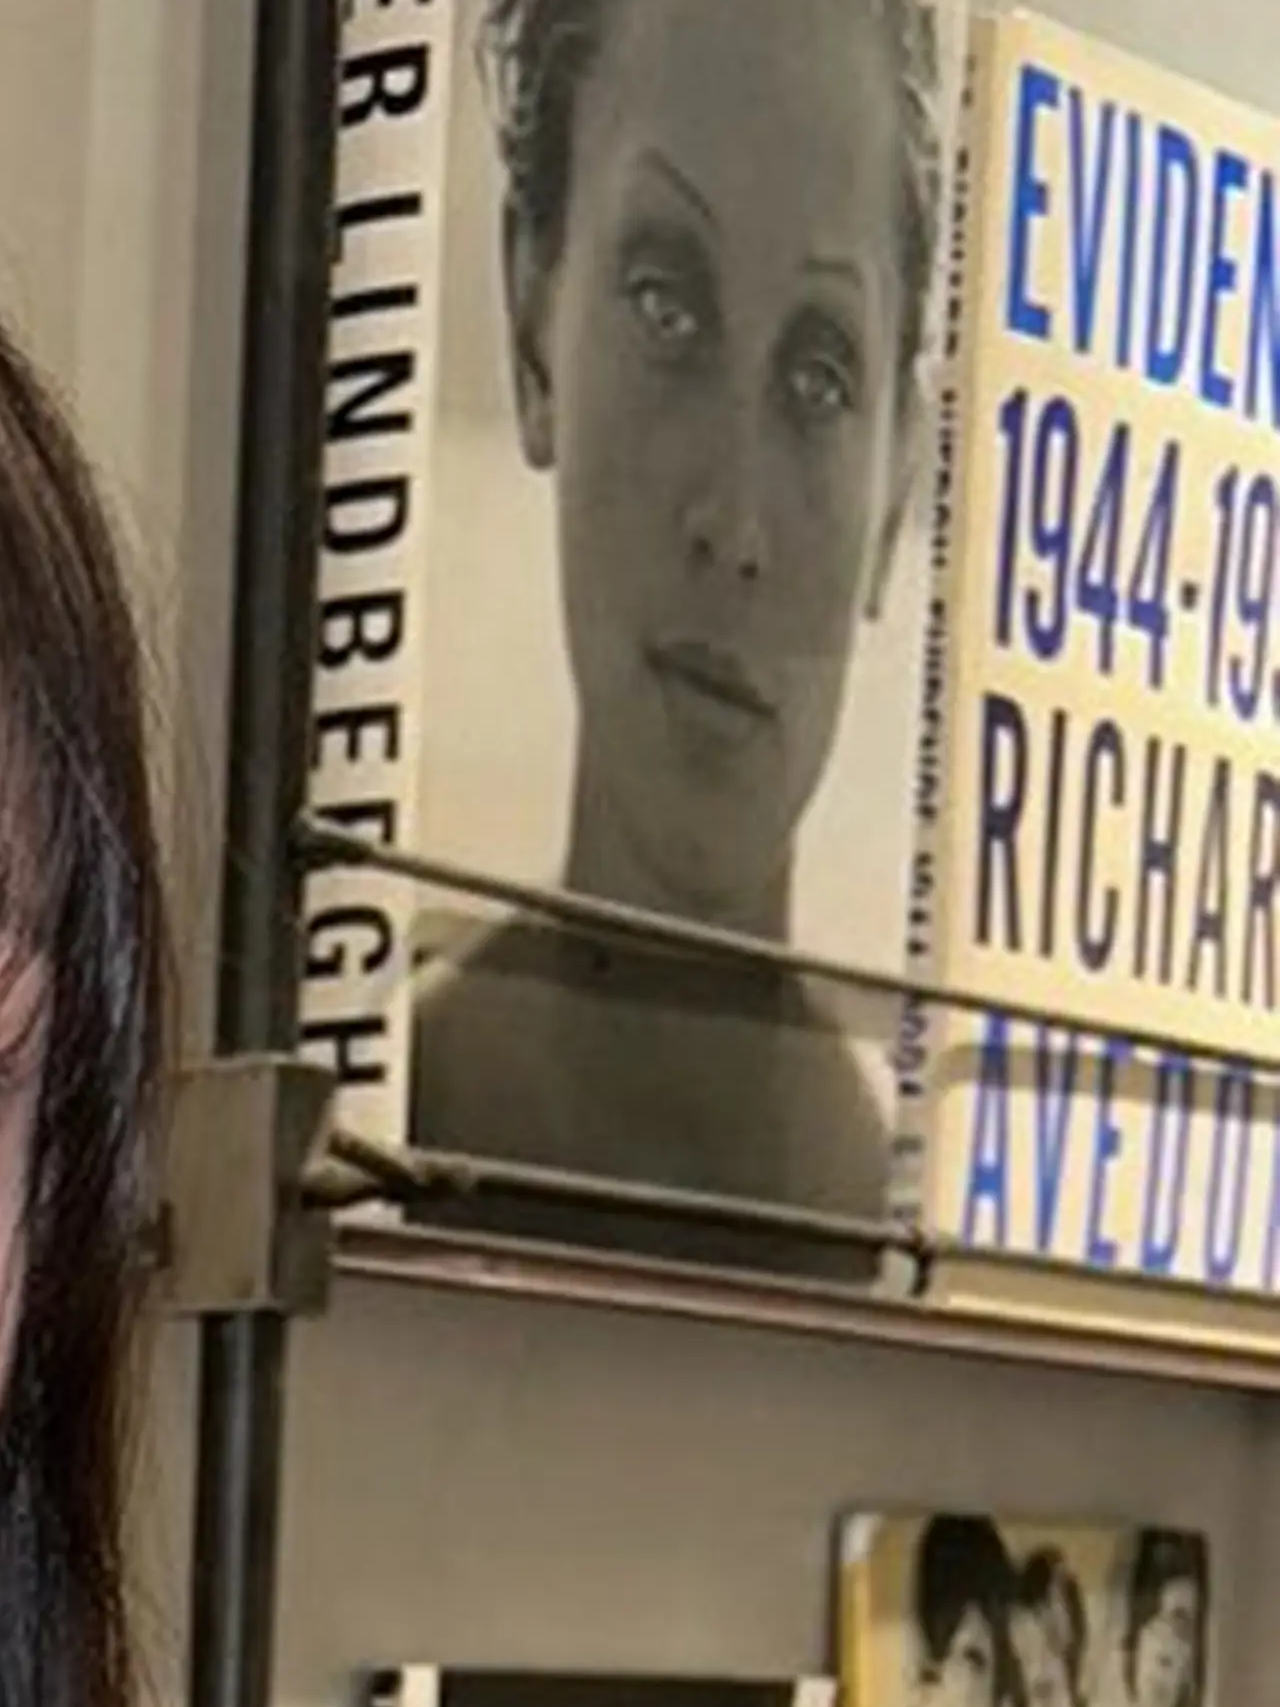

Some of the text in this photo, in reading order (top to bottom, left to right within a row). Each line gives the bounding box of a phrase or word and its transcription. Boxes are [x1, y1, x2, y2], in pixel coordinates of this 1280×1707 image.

[1006, 63, 1280, 431] EVIDEN
[993, 387, 1280, 723] 1944-19
[974, 690, 1280, 1012] RICHAR
